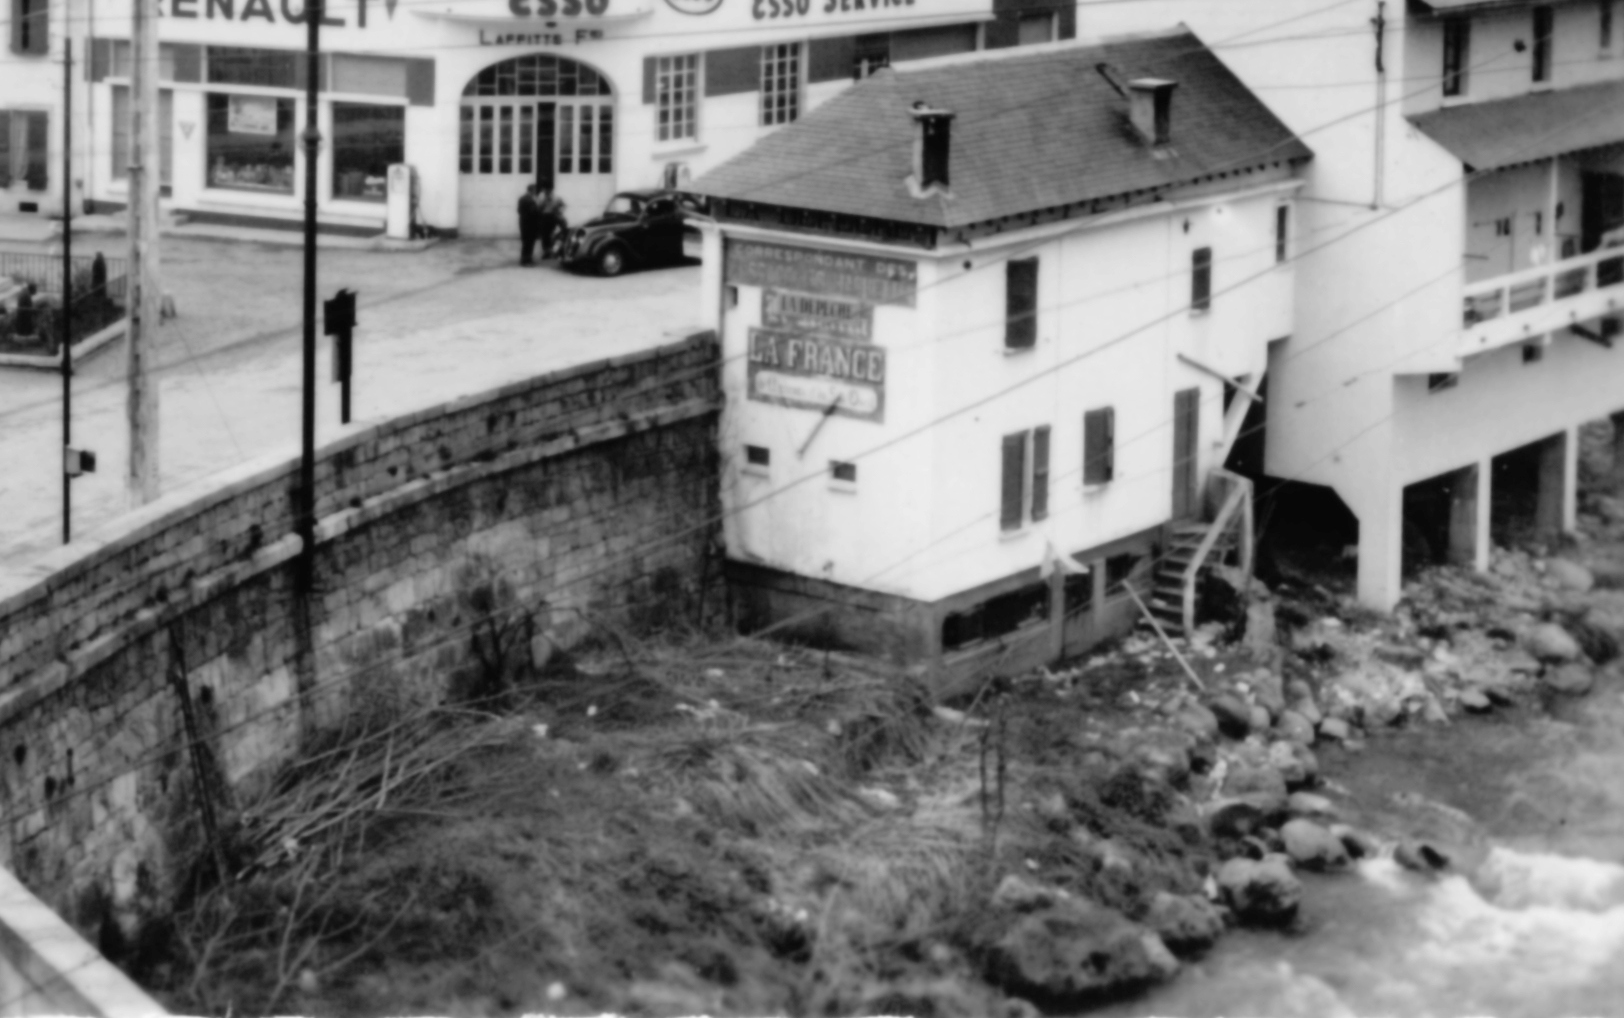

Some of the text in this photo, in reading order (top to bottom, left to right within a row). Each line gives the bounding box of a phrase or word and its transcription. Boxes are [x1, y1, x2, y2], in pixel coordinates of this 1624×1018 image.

[732, 244, 865, 271] CORRESPONDANT
[749, 332, 884, 382] LA FRANCE
